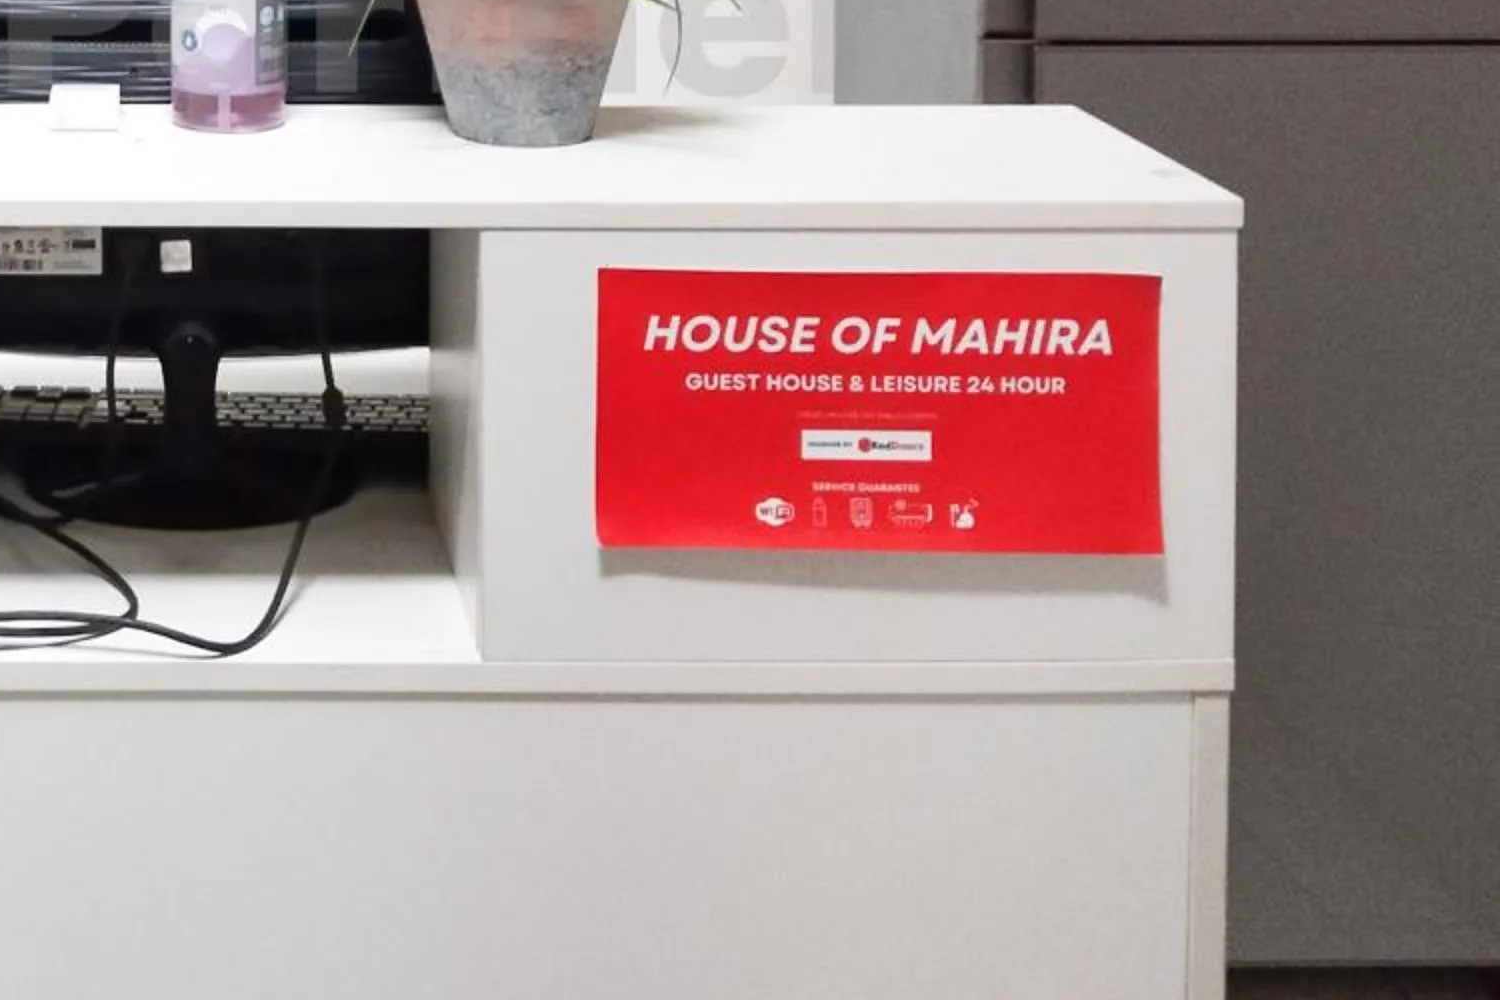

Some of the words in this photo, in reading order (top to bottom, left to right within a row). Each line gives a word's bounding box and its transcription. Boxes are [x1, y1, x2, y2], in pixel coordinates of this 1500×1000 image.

[643, 315, 820, 353] HOUSE
[831, 317, 901, 354] OF
[911, 318, 1114, 356] MAHIRA
[685, 373, 761, 391] GUEST
[766, 374, 844, 392] HOUSE
[849, 375, 864, 392] &
[871, 375, 962, 393] LEISURE
[967, 376, 995, 393] 24
[1000, 376, 1066, 394] HOUR
